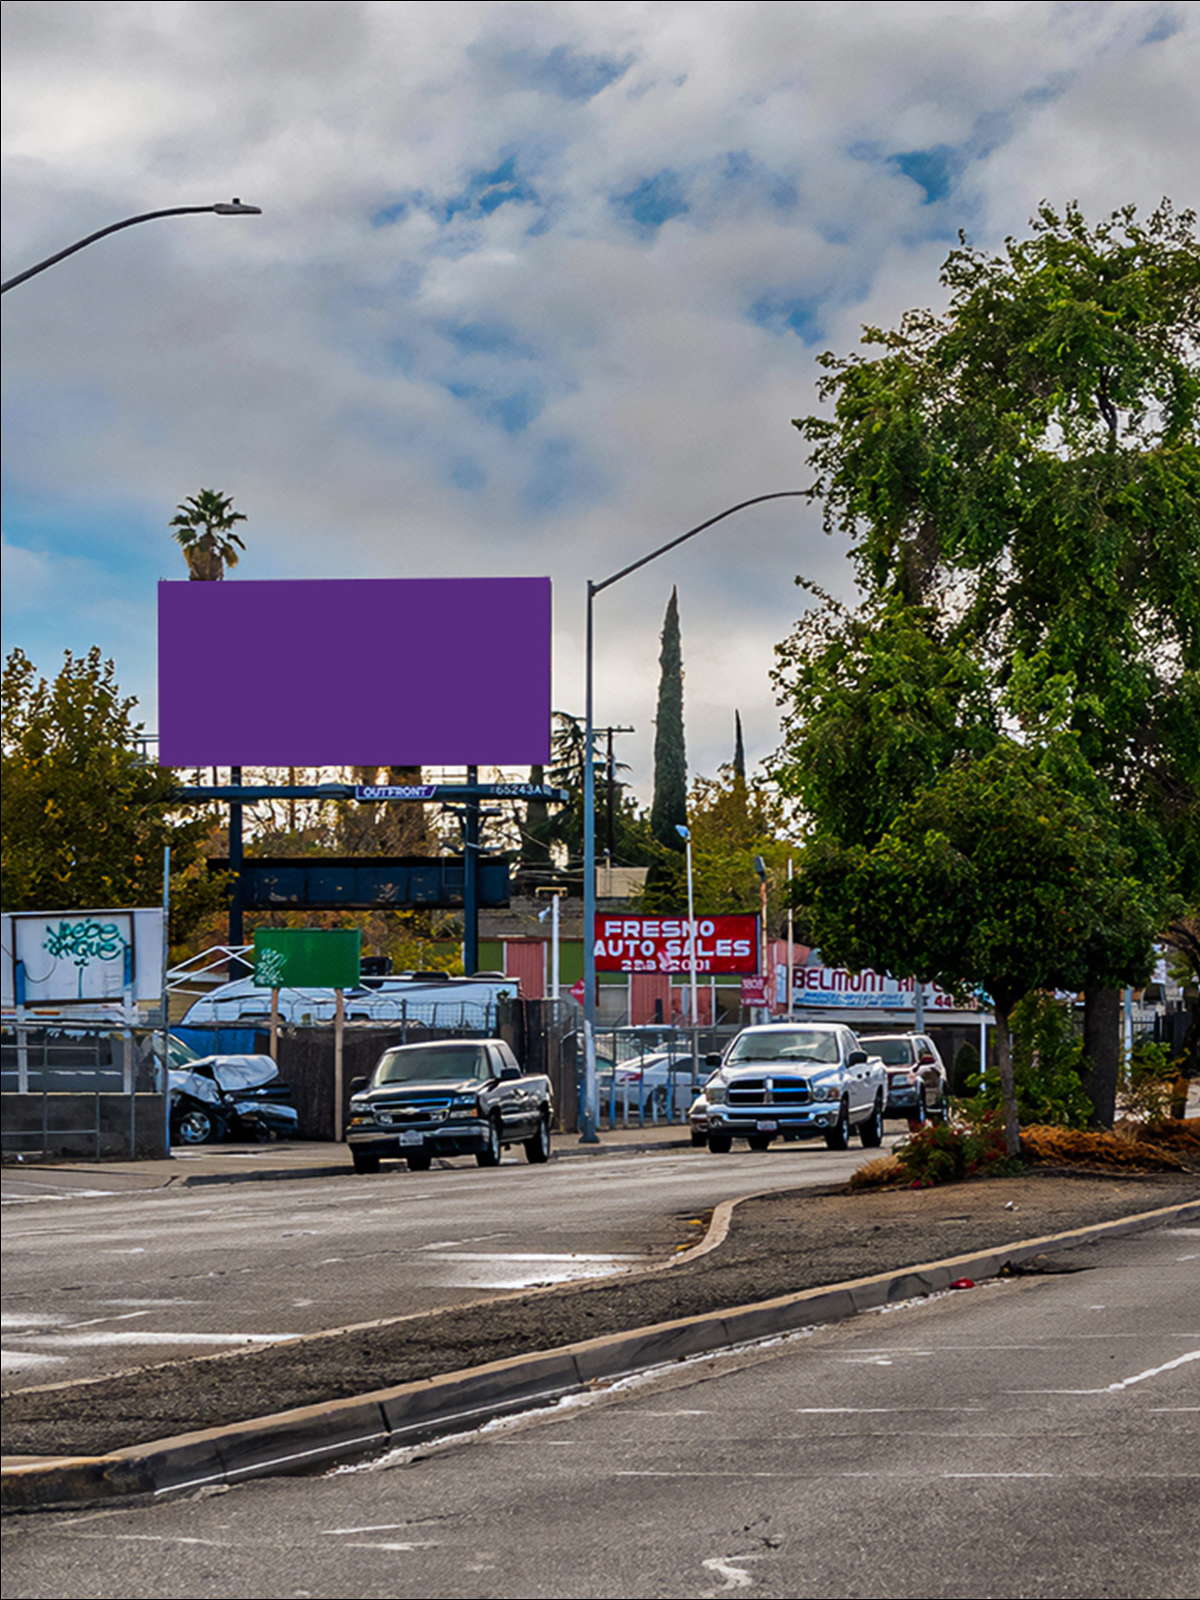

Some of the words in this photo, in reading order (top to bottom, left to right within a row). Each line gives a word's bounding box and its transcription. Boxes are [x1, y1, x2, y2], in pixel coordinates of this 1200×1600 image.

[363, 786, 428, 797] OUTFRONT
[605, 920, 715, 938] FRESNO
[594, 940, 655, 957] AUTO
[665, 939, 751, 957] SALES
